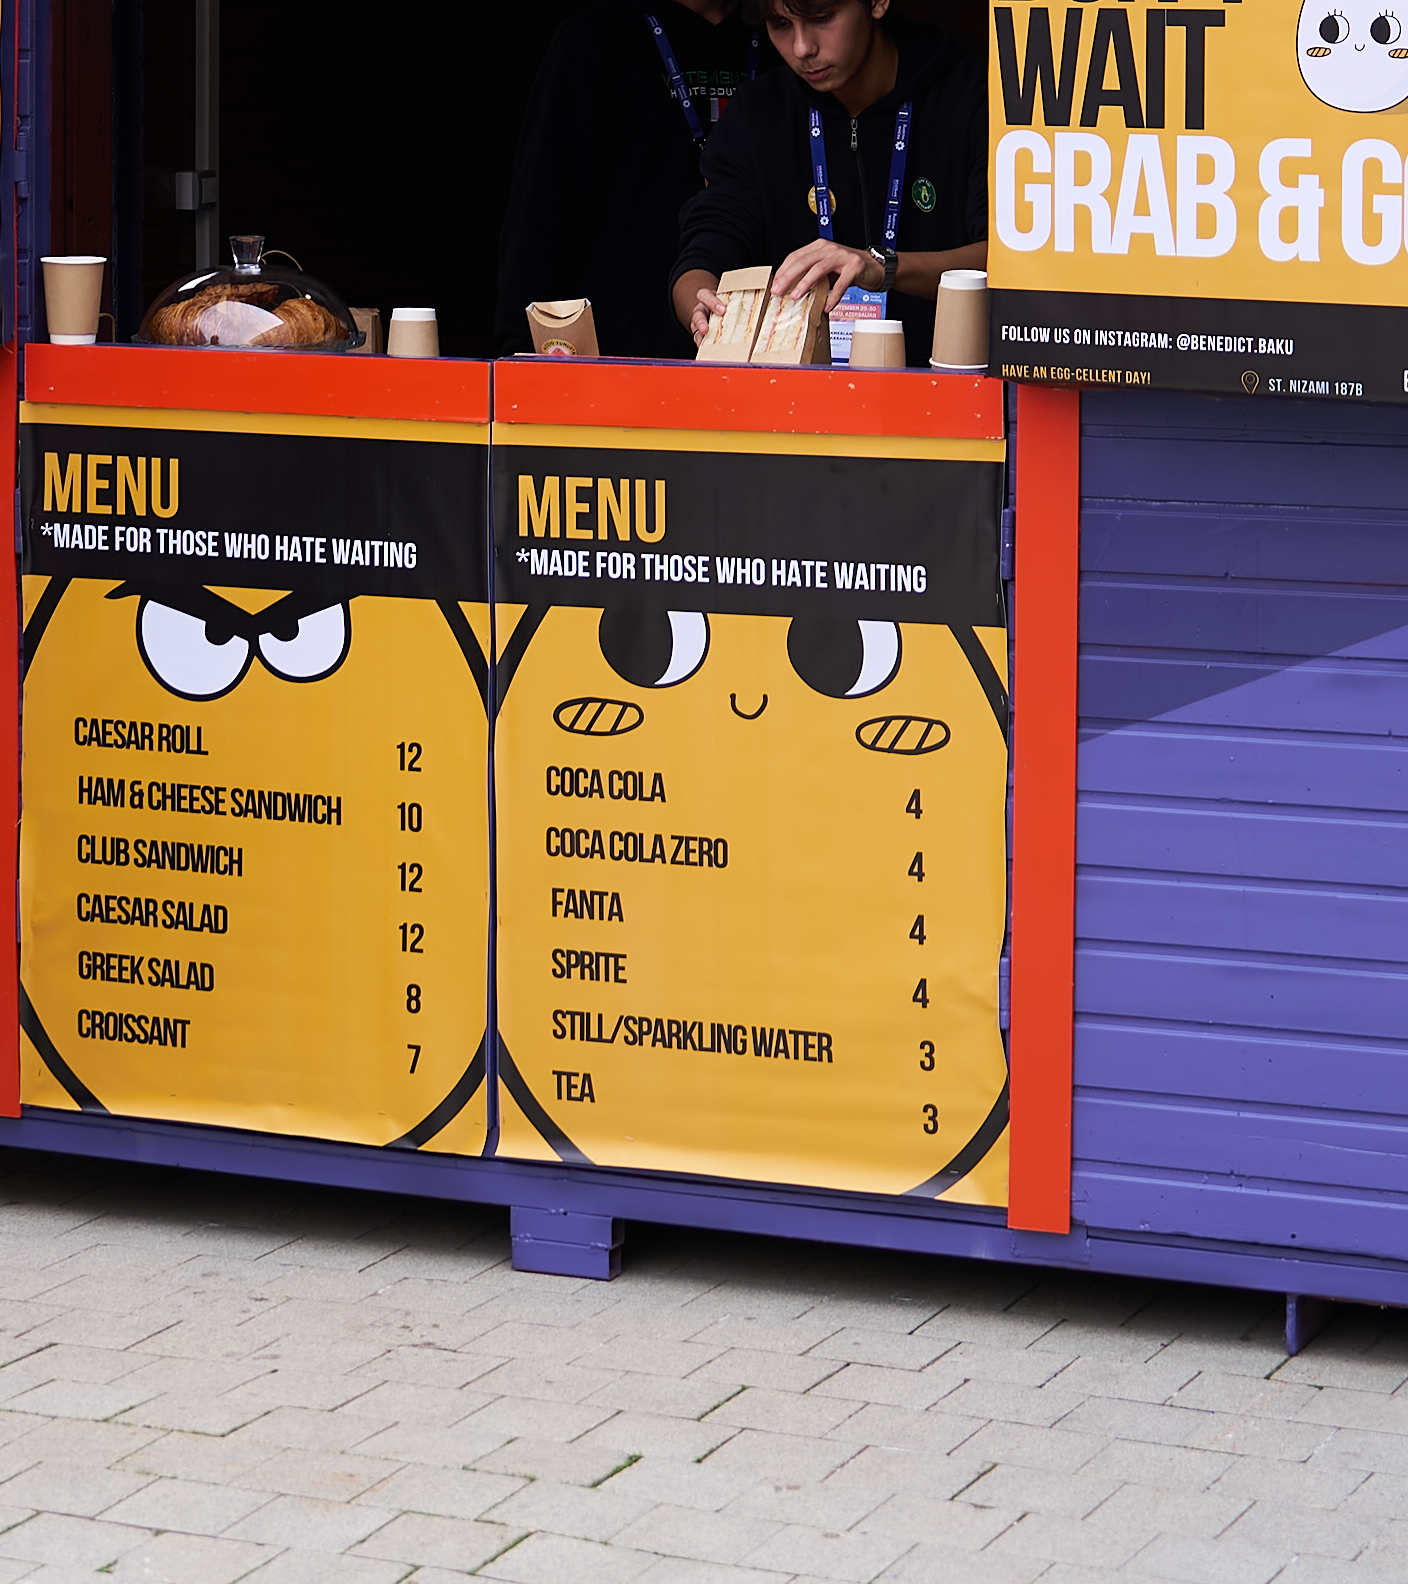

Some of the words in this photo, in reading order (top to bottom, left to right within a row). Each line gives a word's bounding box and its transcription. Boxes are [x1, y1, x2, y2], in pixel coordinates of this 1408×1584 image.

[993, 7, 1226, 130] WAIT
[994, 128, 1237, 259] GRAB
[1257, 136, 1324, 263] &
[1001, 324, 1051, 344] FOLLOW
[1054, 327, 1071, 344] US
[1074, 328, 1091, 345] ON
[1094, 328, 1173, 349] INSTAGRAM:
[1176, 332, 1294, 356] @BENEDICT.BAKU
[1001, 364, 1029, 379] HAVE
[1033, 365, 1048, 379] AN
[1050, 365, 1123, 384] EGG-CELLENT
[1125, 369, 1152, 385] DAY!
[1268, 378, 1286, 392] ST.
[1289, 379, 1330, 395] NIZAMI
[1334, 382, 1364, 396] 187B
[43, 452, 180, 519] MENU
[518, 474, 666, 543] MENU
[114, 526, 151, 554] FOR
[156, 528, 219, 558] THOSE
[224, 532, 270, 560] WHO
[275, 535, 326, 564] HATE
[332, 538, 417, 569] WAITING
[595, 551, 636, 580] FOR
[641, 553, 709, 584] THOSE
[715, 556, 765, 586] WHO
[771, 558, 827, 589] HATE
[833, 561, 927, 593] WAITING
[74, 717, 154, 752] CAESAR
[158, 724, 209, 756] ROLL
[396, 741, 422, 772] 12
[78, 775, 126, 808] HAM
[129, 780, 145, 810] &
[147, 781, 227, 817] CHEESE
[230, 788, 342, 826] SANDWICH
[397, 802, 423, 833] 10
[546, 765, 604, 799] COCA
[608, 768, 666, 802] COLA
[905, 788, 923, 819] 4
[77, 834, 130, 867] CLUB
[133, 838, 243, 877] SANDWICH
[397, 862, 423, 893] 12
[546, 827, 605, 860] COCA
[609, 830, 667, 864] COLA
[670, 834, 728, 868] ZERO
[908, 851, 925, 882] 4
[77, 893, 158, 928] CAESAR
[161, 900, 228, 934] SALAD
[398, 922, 425, 954] 12
[551, 887, 624, 922] FANTA
[909, 914, 926, 945] 4
[78, 950, 144, 985] GREEK
[147, 957, 215, 992] SALAD
[406, 983, 422, 1014] 8
[552, 948, 627, 984] SPRITE
[912, 978, 929, 1008] 4
[77, 1009, 191, 1049] CROISSANT
[406, 1044, 422, 1074] 7
[552, 1009, 747, 1056] STILL/SPARKLING
[752, 1026, 833, 1063] WATER
[919, 1040, 935, 1071] 3
[552, 1070, 595, 1103] TEA
[922, 1103, 939, 1134] 3
